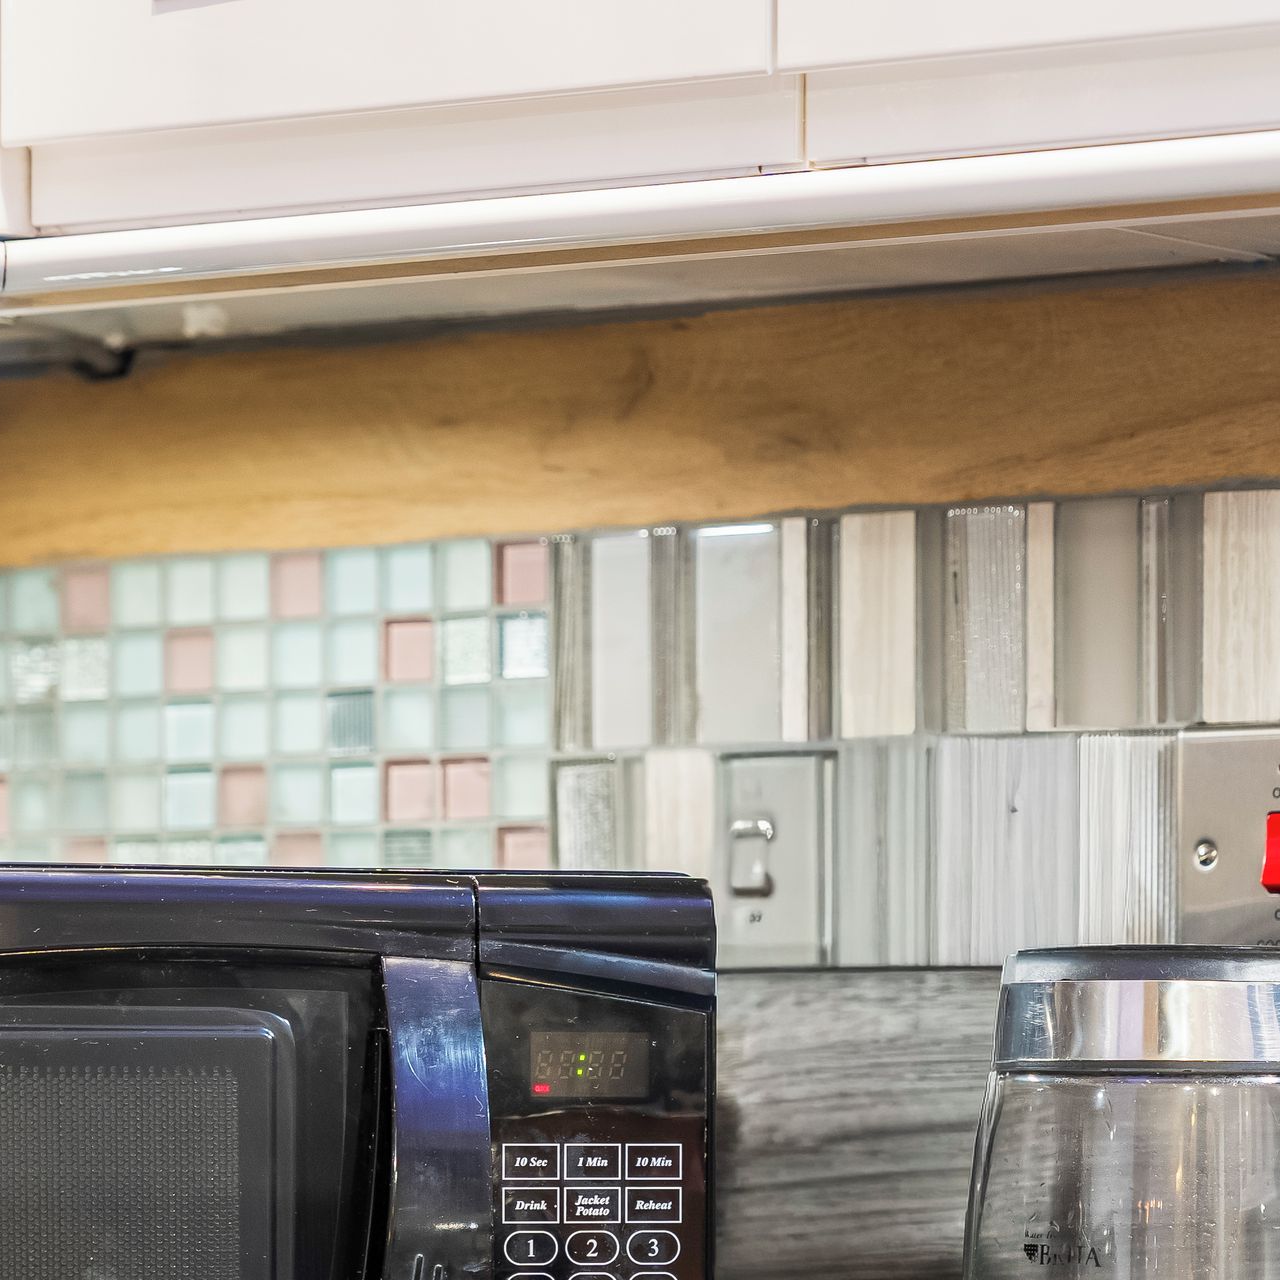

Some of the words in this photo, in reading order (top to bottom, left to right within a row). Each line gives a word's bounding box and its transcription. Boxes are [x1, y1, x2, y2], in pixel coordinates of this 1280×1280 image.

[514, 1157, 528, 1167] 10
[529, 1156, 548, 1167] Sec
[577, 1157, 583, 1167] 1
[585, 1156, 608, 1167] Min
[635, 1157, 649, 1167] 10
[649, 1156, 673, 1167] Min
[515, 1200, 547, 1210] Drink
[574, 1195, 610, 1206] Jacket
[634, 1200, 672, 1210] Reheat
[575, 1206, 610, 1216] Potato
[527, 1240, 535, 1257] 1
[586, 1239, 599, 1257] 2
[647, 1238, 659, 1257] 3
